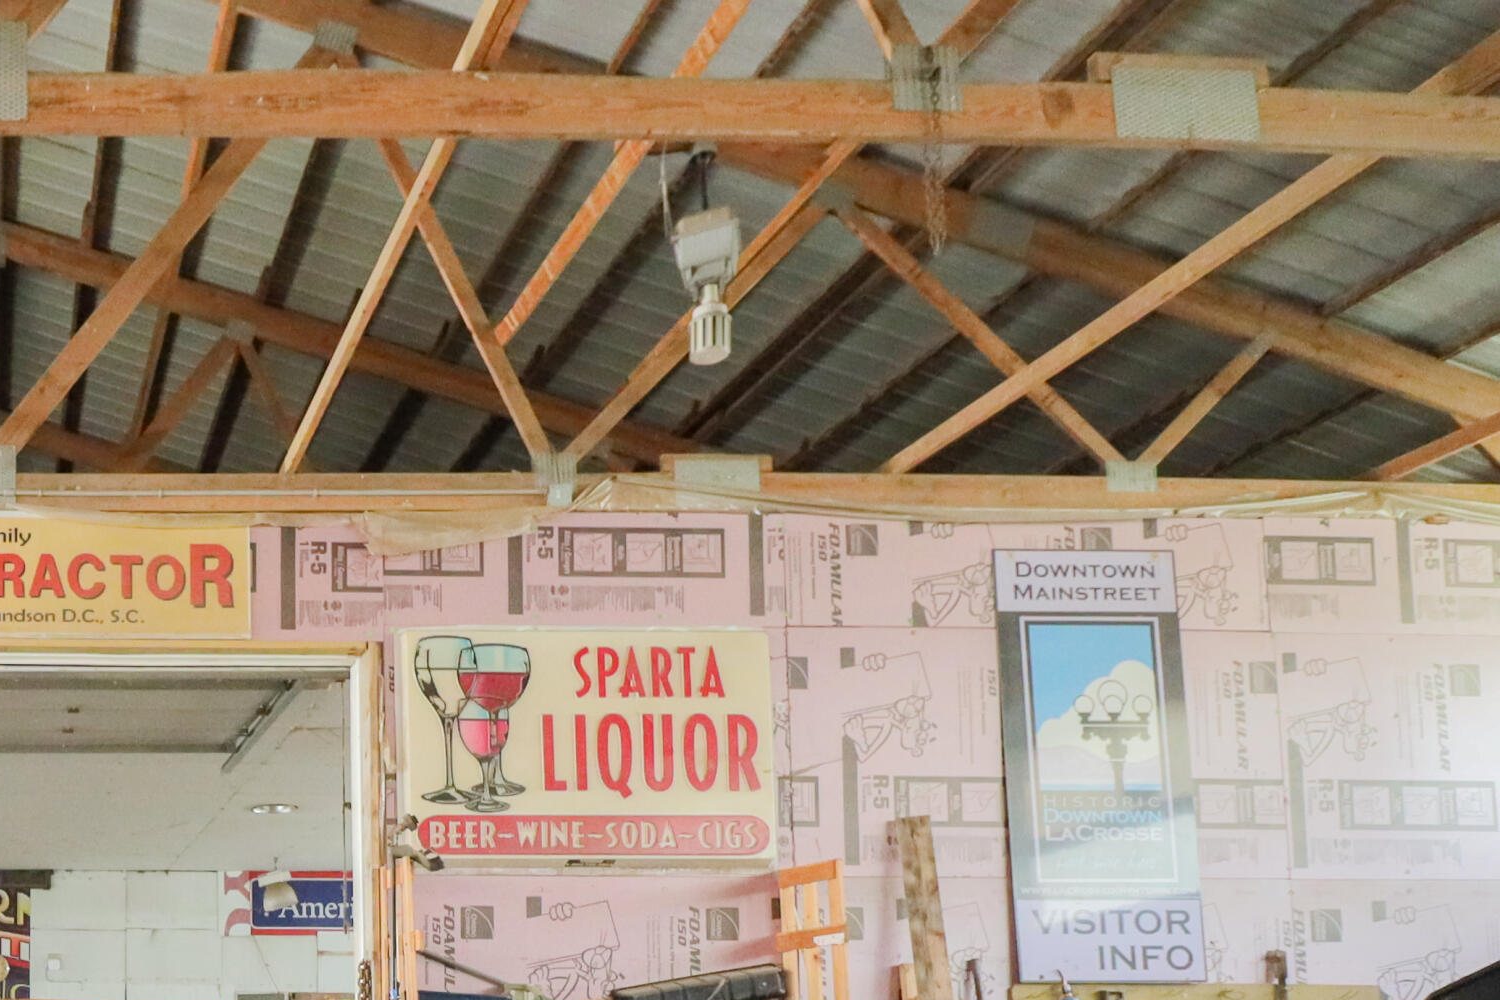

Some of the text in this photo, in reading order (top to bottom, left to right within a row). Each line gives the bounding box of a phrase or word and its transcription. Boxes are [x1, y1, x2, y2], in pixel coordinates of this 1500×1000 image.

[1015, 561, 1156, 578] DOWNTOWN
[1013, 584, 1161, 601] MAINSTREET
[110, 608, 145, 624] S.C.
[573, 646, 726, 698] SPARTA
[542, 713, 762, 799] LIQUOR
[1043, 796, 1161, 808] HISTORIC
[1043, 809, 1162, 824] DOWNTOWN
[1032, 909, 1191, 935] VISITOR
[1098, 945, 1194, 970] INFO
